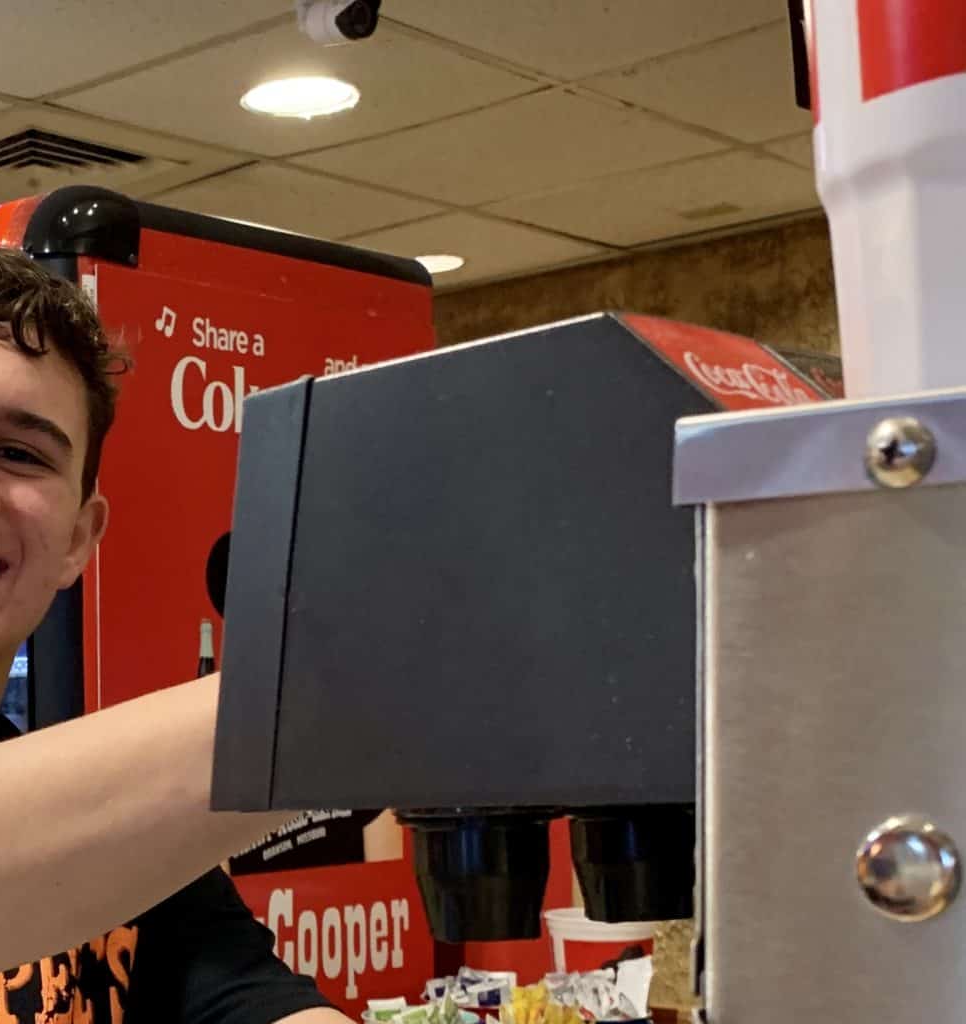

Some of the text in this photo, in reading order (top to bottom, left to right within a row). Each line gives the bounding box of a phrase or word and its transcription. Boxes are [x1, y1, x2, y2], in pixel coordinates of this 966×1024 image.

[192, 317, 264, 356] Share a
[267, 887, 409, 1000] Cooper
